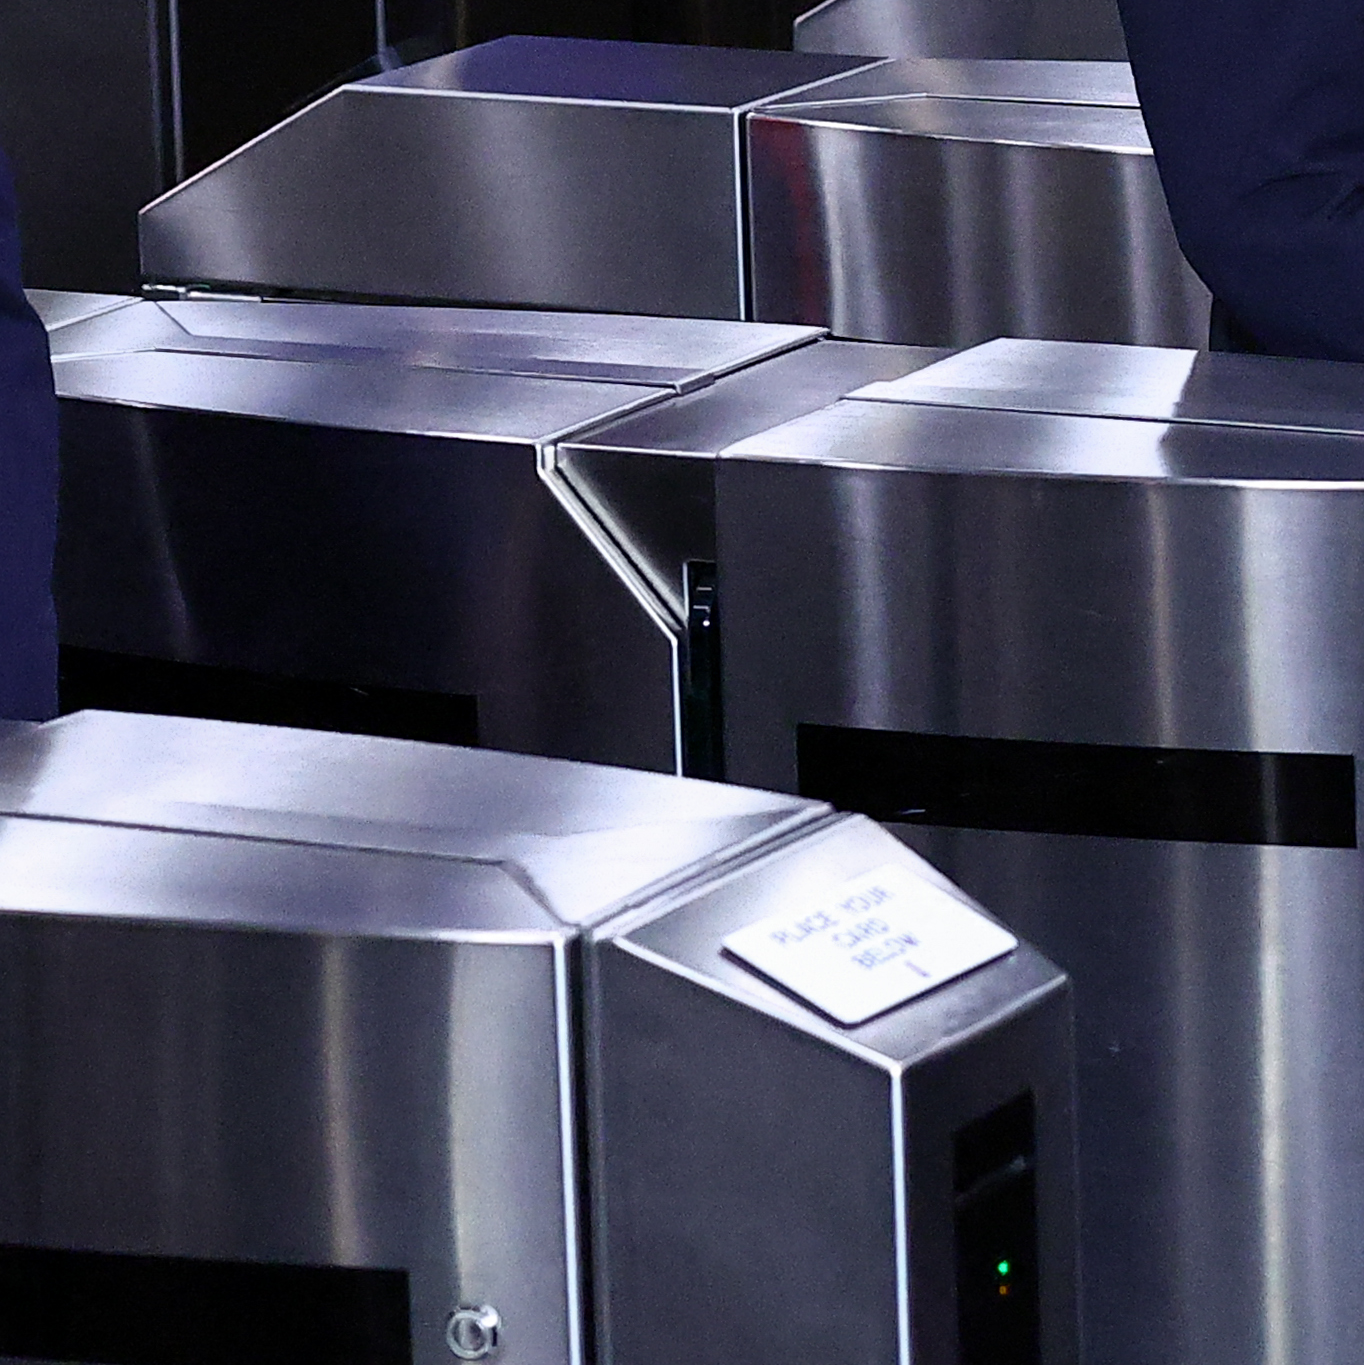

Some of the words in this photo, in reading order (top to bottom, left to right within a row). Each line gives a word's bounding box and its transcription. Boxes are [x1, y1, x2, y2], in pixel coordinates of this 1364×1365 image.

[771, 912, 838, 944] PLACE
[838, 888, 893, 913] YOUR
[832, 919, 888, 947] CARD
[852, 934, 919, 968] BELOW
